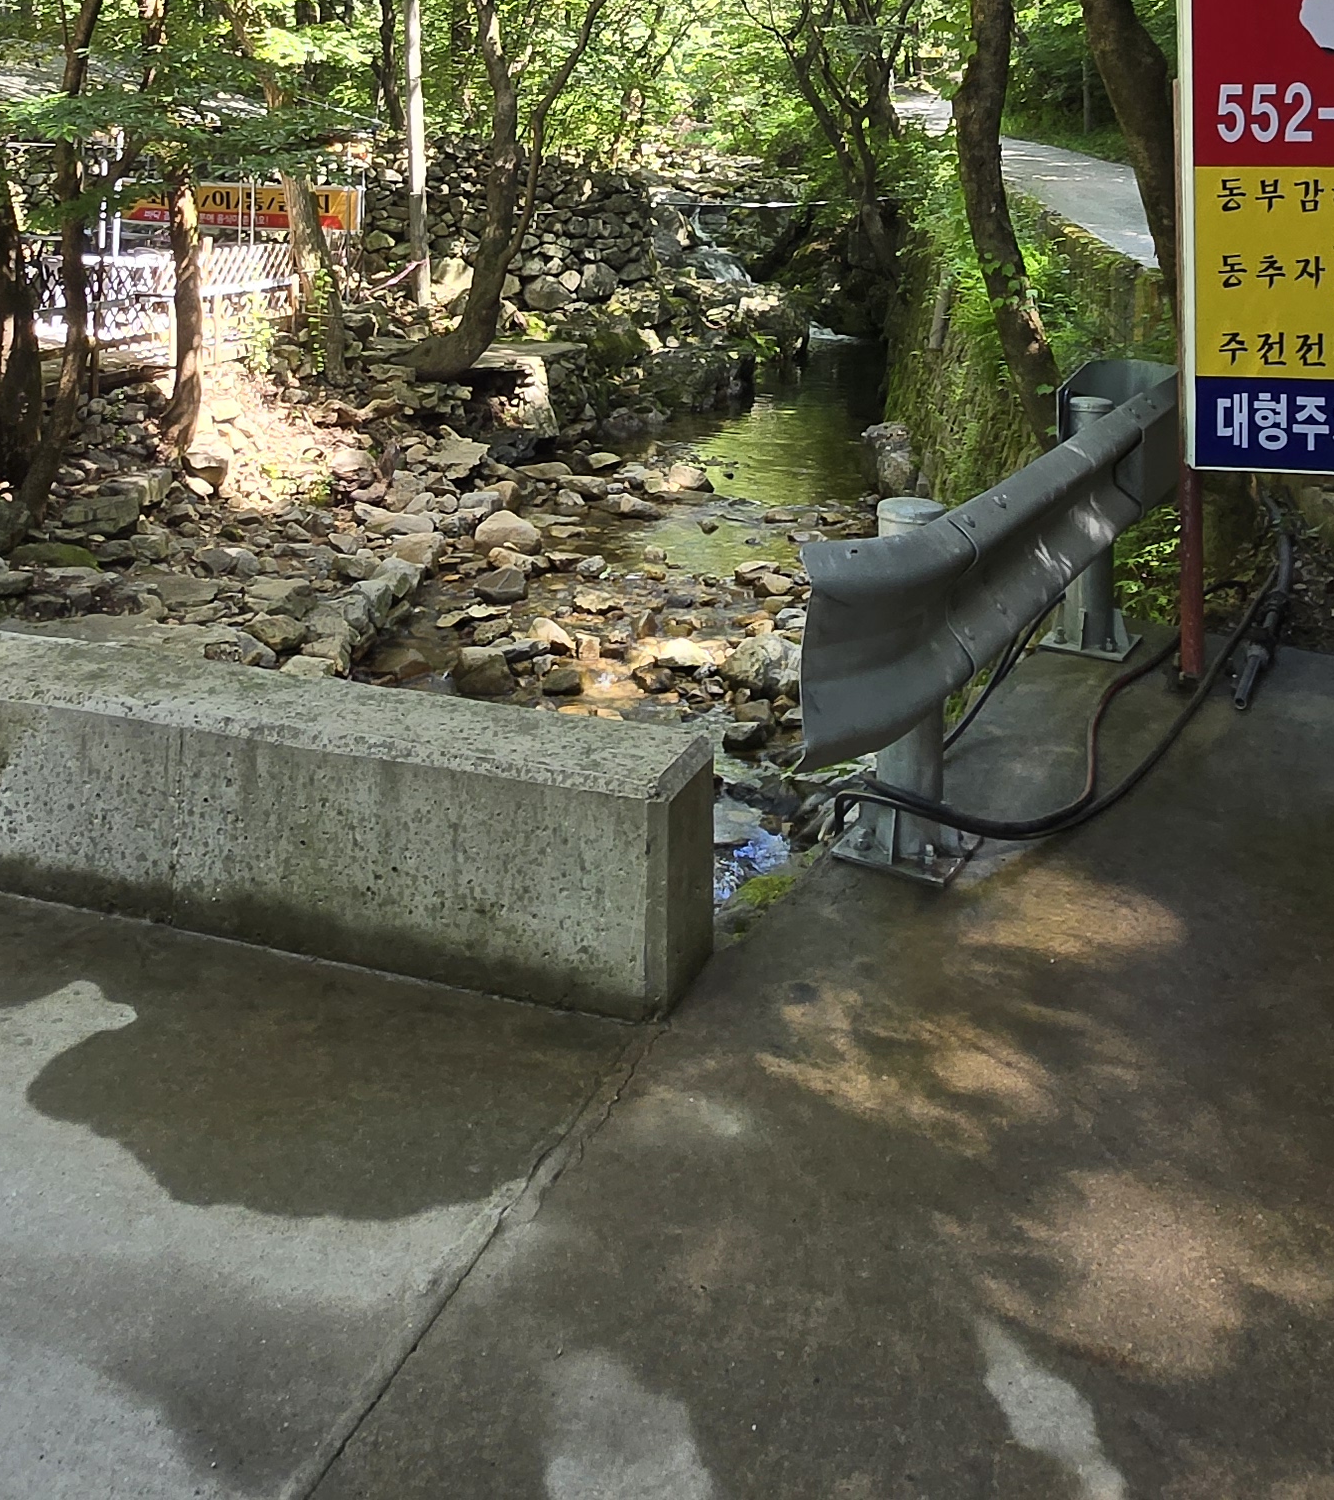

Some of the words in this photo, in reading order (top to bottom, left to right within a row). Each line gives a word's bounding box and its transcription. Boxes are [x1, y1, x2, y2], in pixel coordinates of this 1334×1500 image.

[1216, 177, 1249, 366] 동동주
[1254, 179, 1287, 367] 부추전
[1293, 179, 1327, 368] 감자전
